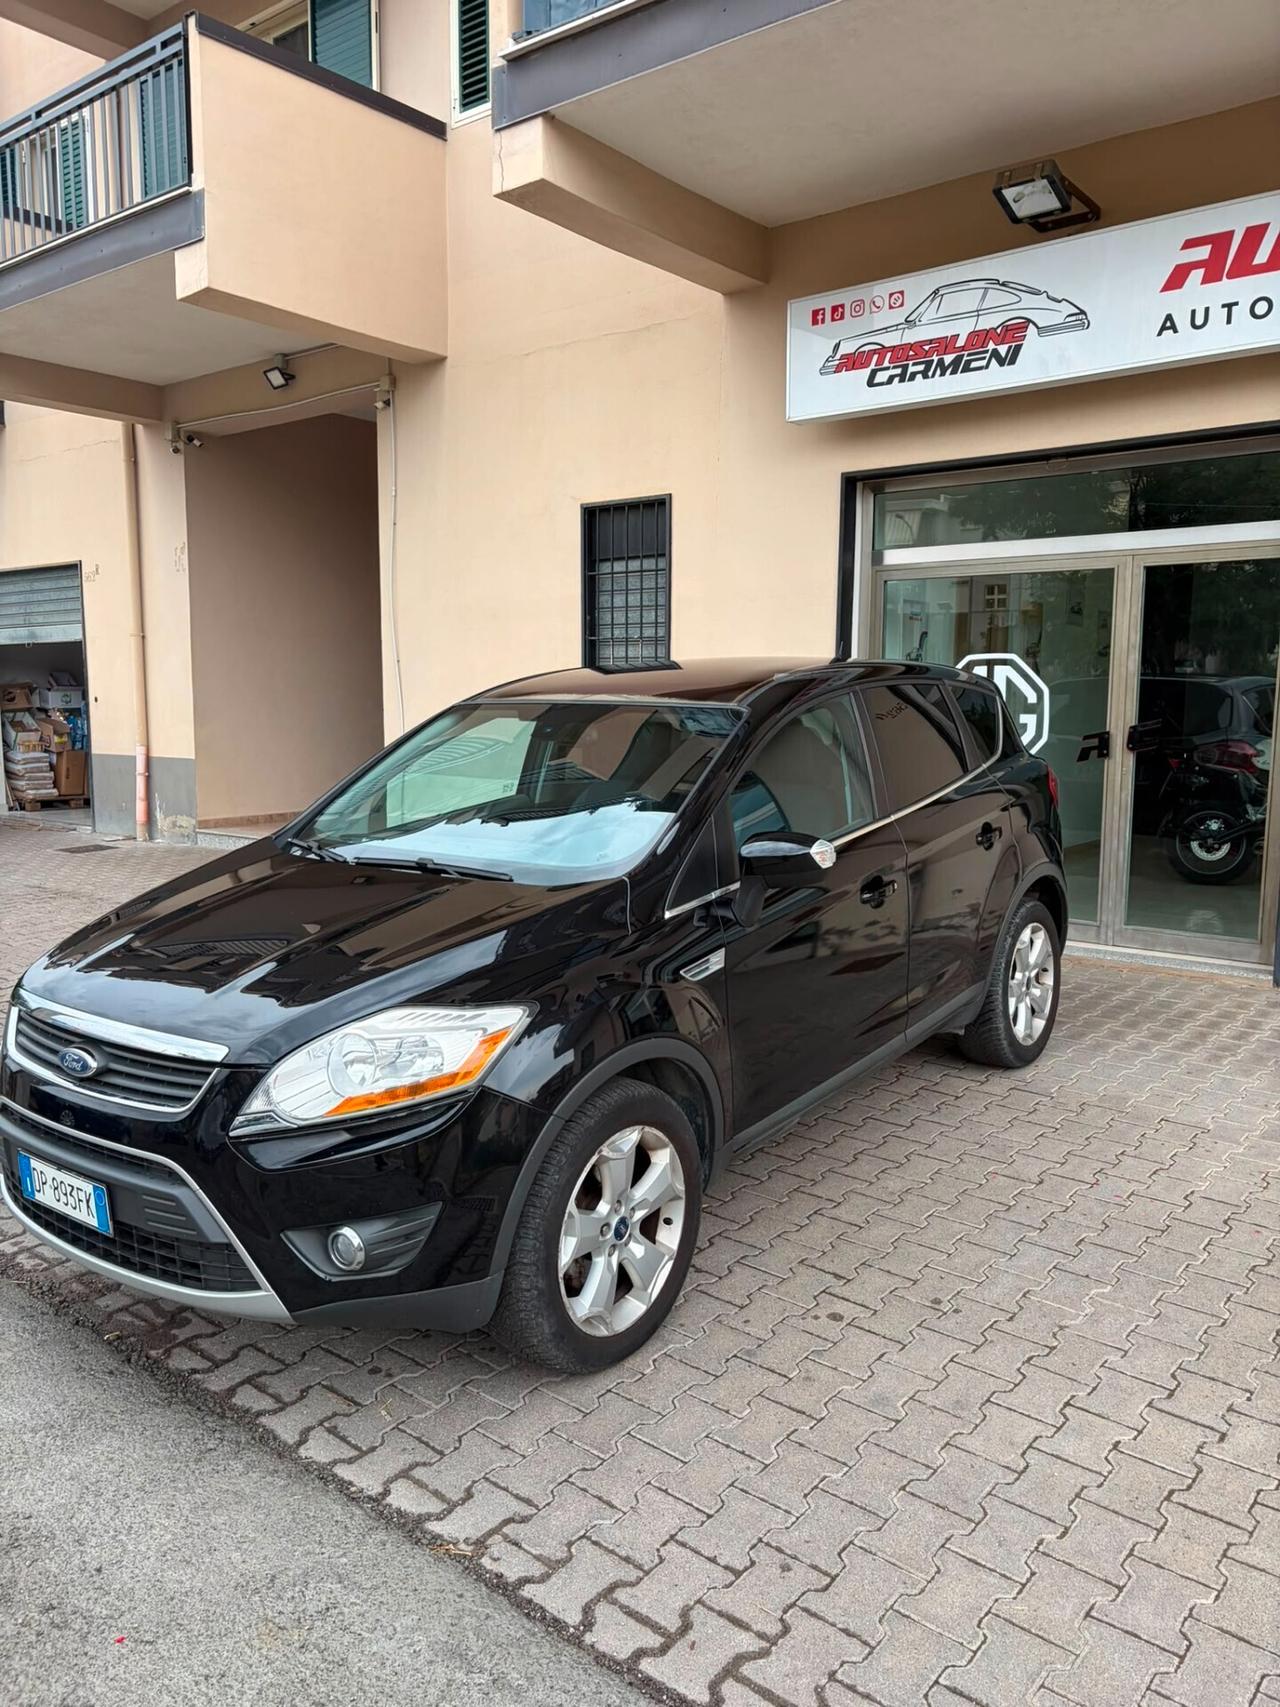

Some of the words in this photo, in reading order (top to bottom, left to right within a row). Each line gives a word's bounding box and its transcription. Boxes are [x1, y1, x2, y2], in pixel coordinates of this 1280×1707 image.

[1156, 296, 1273, 337] AUTO
[834, 320, 1030, 373] AUTOSALONE
[866, 343, 1023, 388] CARMENI
[972, 665, 1037, 747] G
[63, 1052, 84, 1072] Ford
[52, 1177, 95, 1218] 893FK
